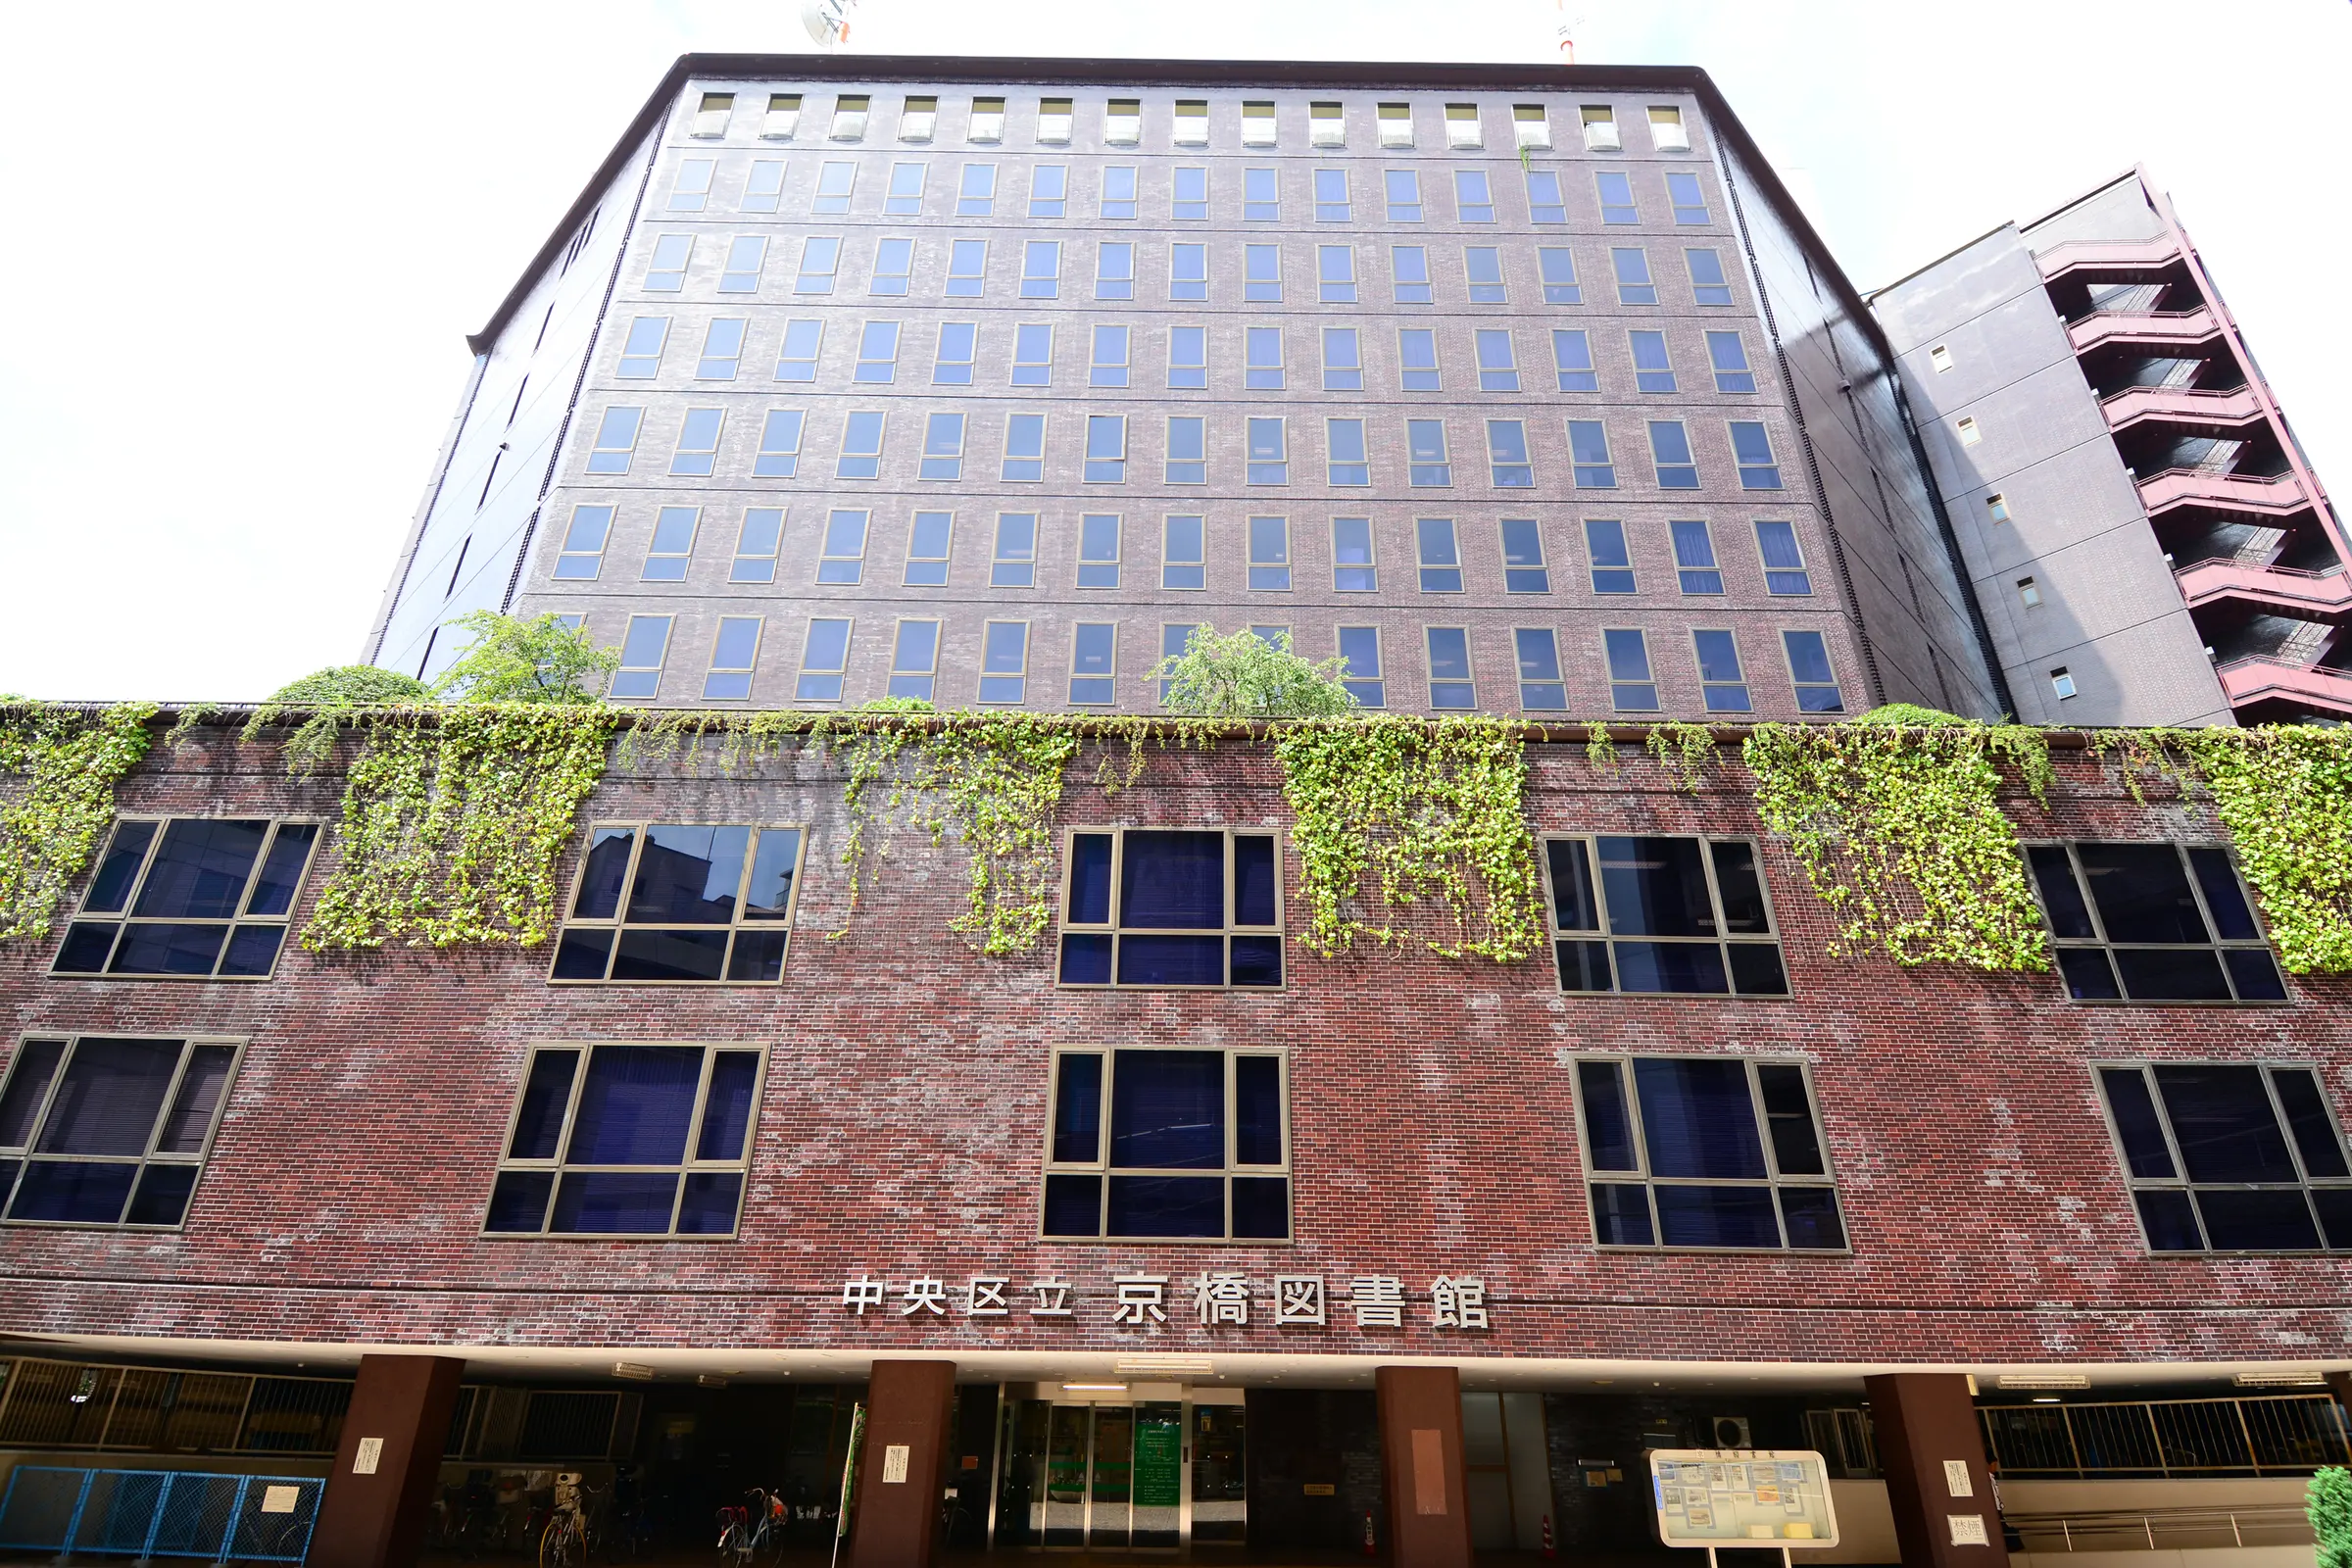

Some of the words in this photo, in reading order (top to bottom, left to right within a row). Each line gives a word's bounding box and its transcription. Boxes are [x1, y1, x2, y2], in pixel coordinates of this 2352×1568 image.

[842, 1271, 1489, 1330] 中央区立京橋図書館
[1953, 1520, 1982, 1536] 禁煙
